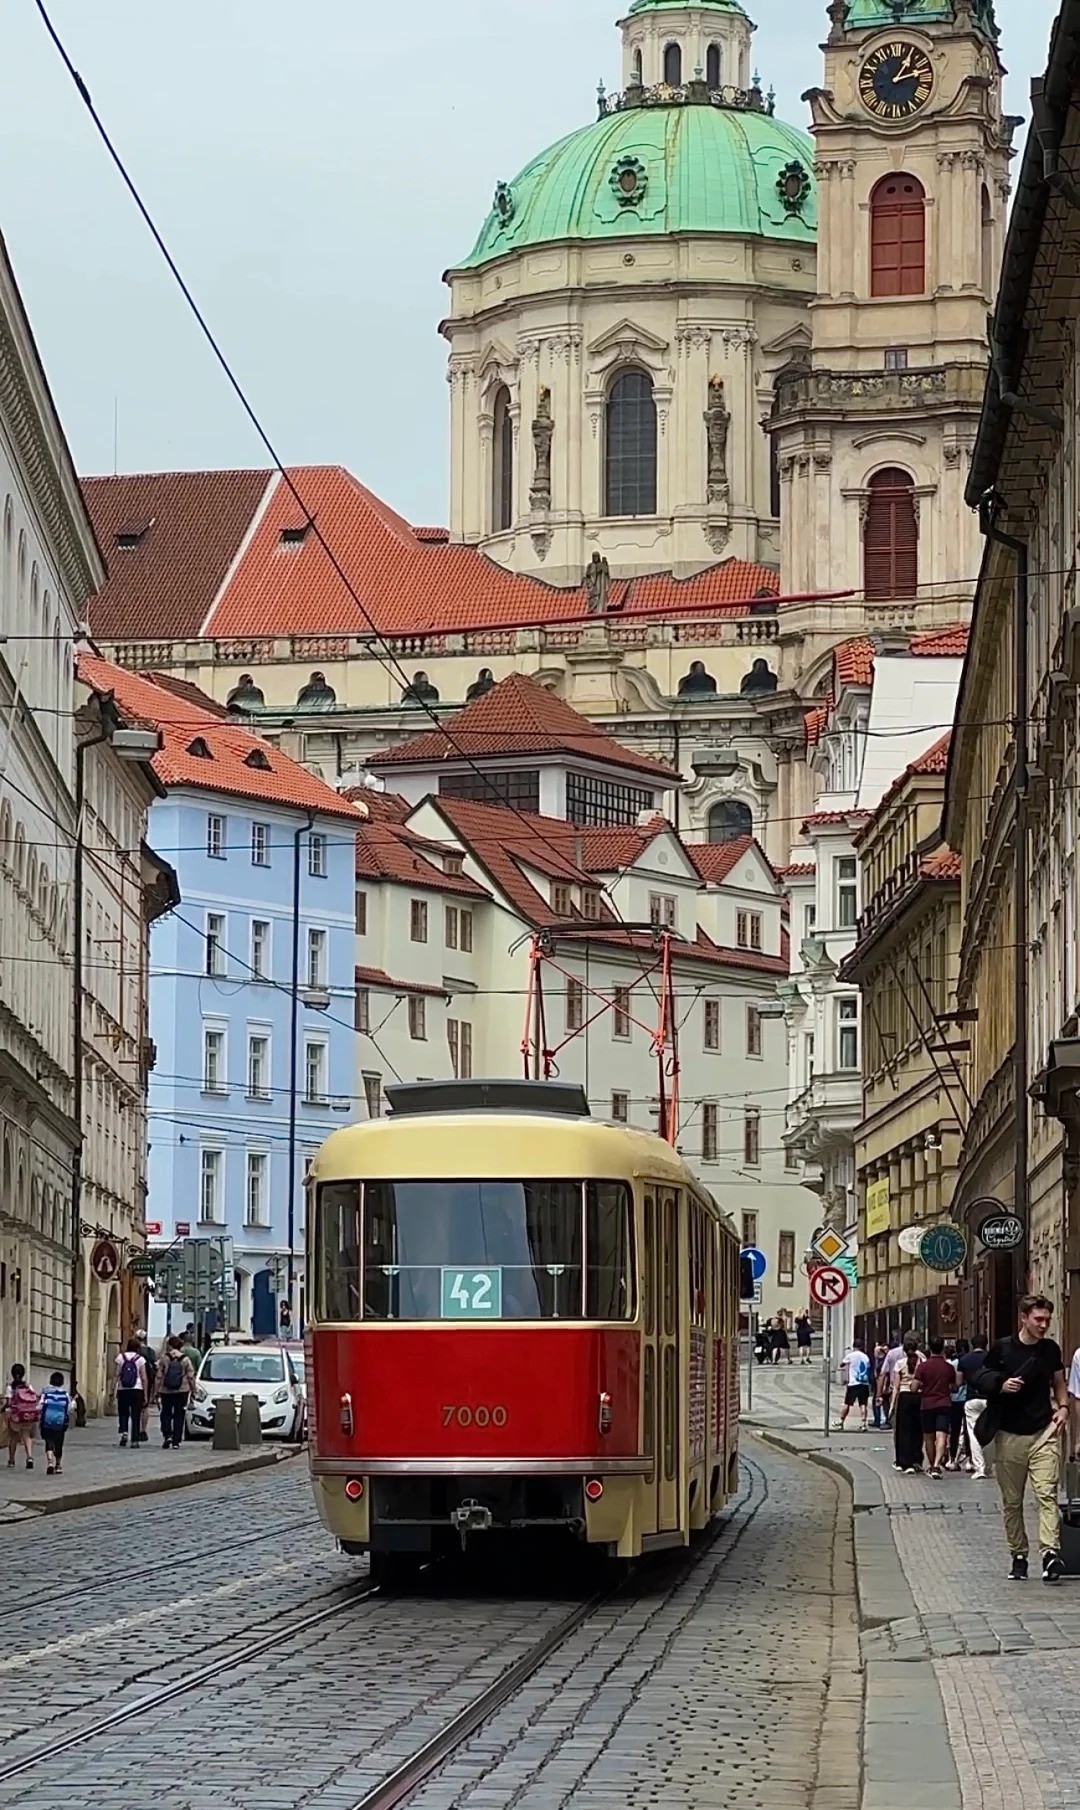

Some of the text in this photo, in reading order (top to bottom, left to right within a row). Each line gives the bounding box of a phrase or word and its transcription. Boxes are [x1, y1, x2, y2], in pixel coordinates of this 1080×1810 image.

[875, 48, 887, 63] XI
[864, 62, 877, 73] X
[450, 1273, 492, 1309] 42
[442, 1406, 507, 1427] 7000
